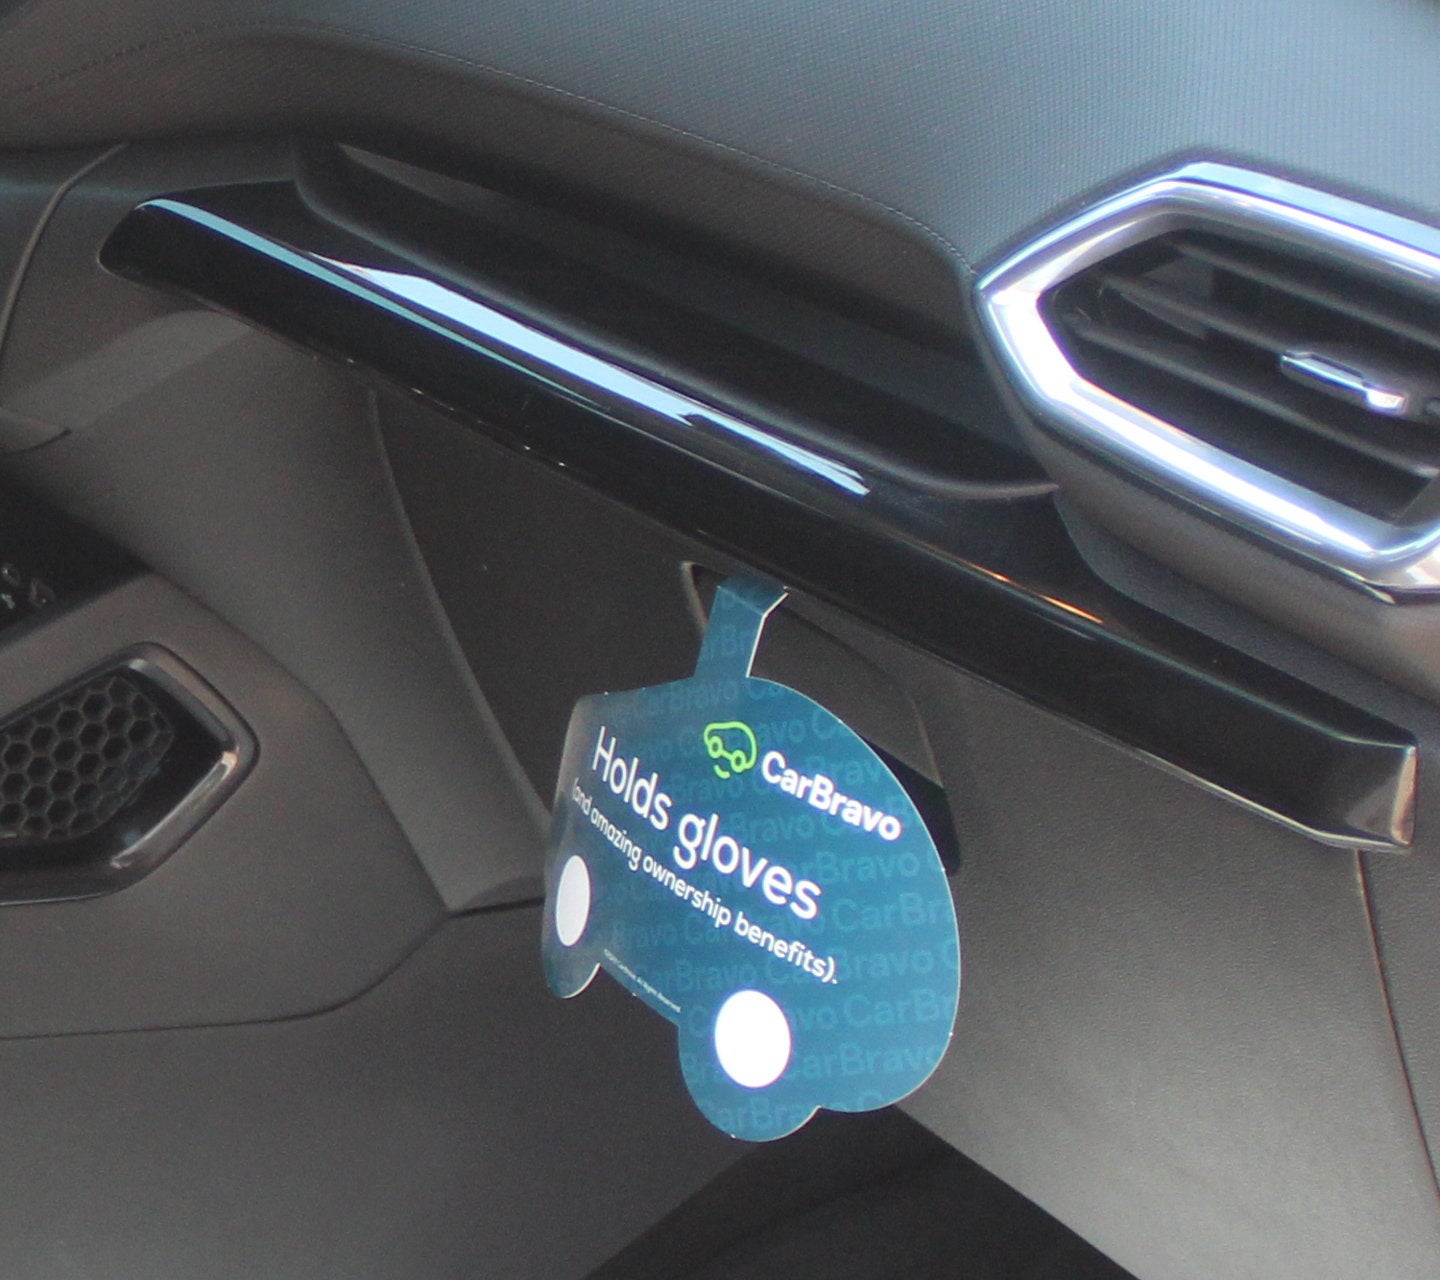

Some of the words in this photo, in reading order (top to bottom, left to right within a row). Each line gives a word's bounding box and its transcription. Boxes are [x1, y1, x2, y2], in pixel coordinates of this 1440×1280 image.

[571, 777, 593, 816] (and
[590, 807, 643, 871] amazing
[642, 855, 732, 929] ownership
[733, 910, 839, 985] benefits).
[592, 725, 672, 830] Holds
[672, 812, 822, 920] gloves
[760, 749, 903, 842] CarBravo
